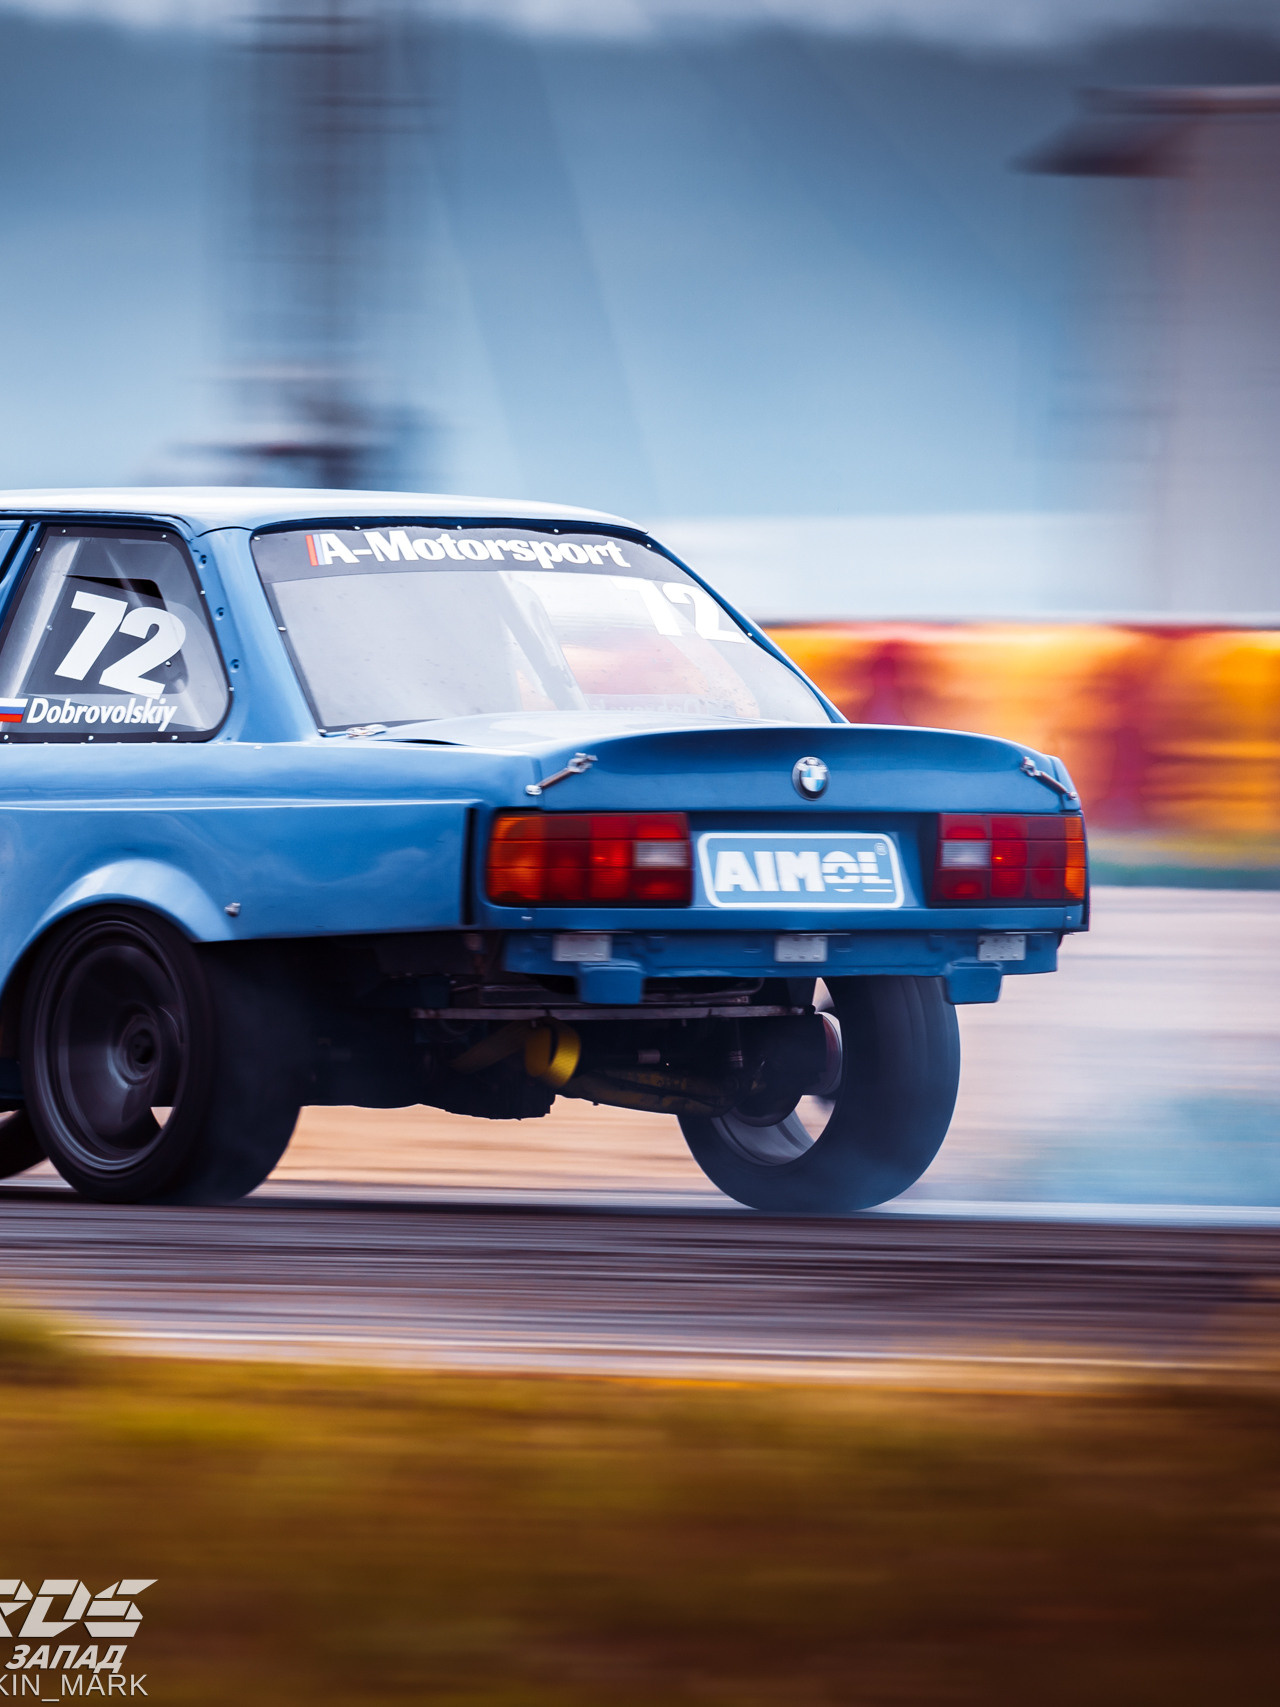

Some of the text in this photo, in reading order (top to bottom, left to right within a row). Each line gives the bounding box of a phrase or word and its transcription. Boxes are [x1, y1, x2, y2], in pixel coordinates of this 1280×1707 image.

[319, 530, 631, 569] A-Motorsport
[610, 577, 747, 644] 72
[54, 590, 187, 700] 72
[26, 697, 178, 732] Dobrovolskiy
[715, 851, 894, 892] AIMOL
